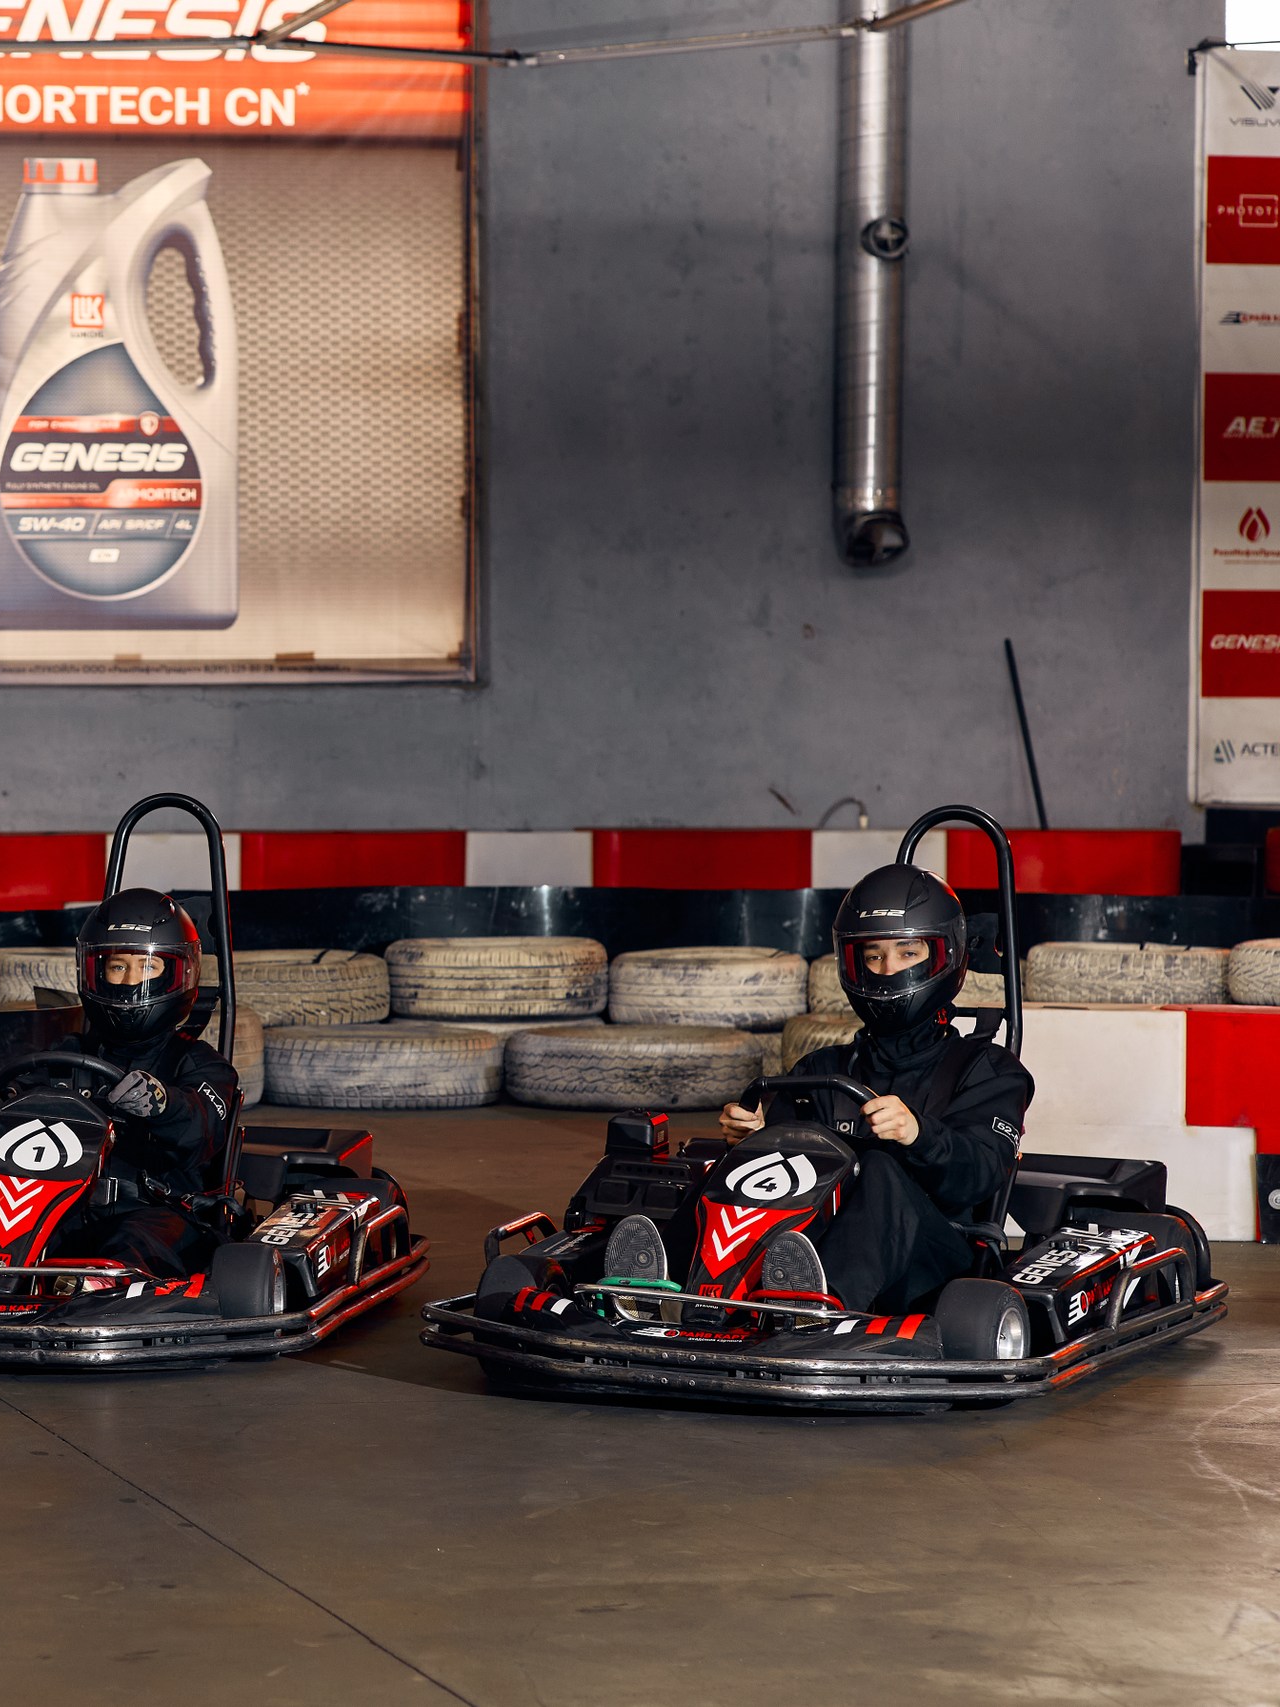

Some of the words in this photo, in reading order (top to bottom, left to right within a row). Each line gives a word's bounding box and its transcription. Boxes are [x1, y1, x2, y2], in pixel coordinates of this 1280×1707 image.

[9, 442, 188, 472] GENESIS
[18, 516, 87, 532] 5W-40
[859, 909, 906, 918] LS2
[107, 923, 153, 932] LS2
[32, 1146, 46, 1163] 1
[753, 1177, 777, 1192] 4
[1012, 1249, 1079, 1285] GENES
[8, 1303, 42, 1312] КАРТ
[713, 1332, 749, 1340] КАРТ
